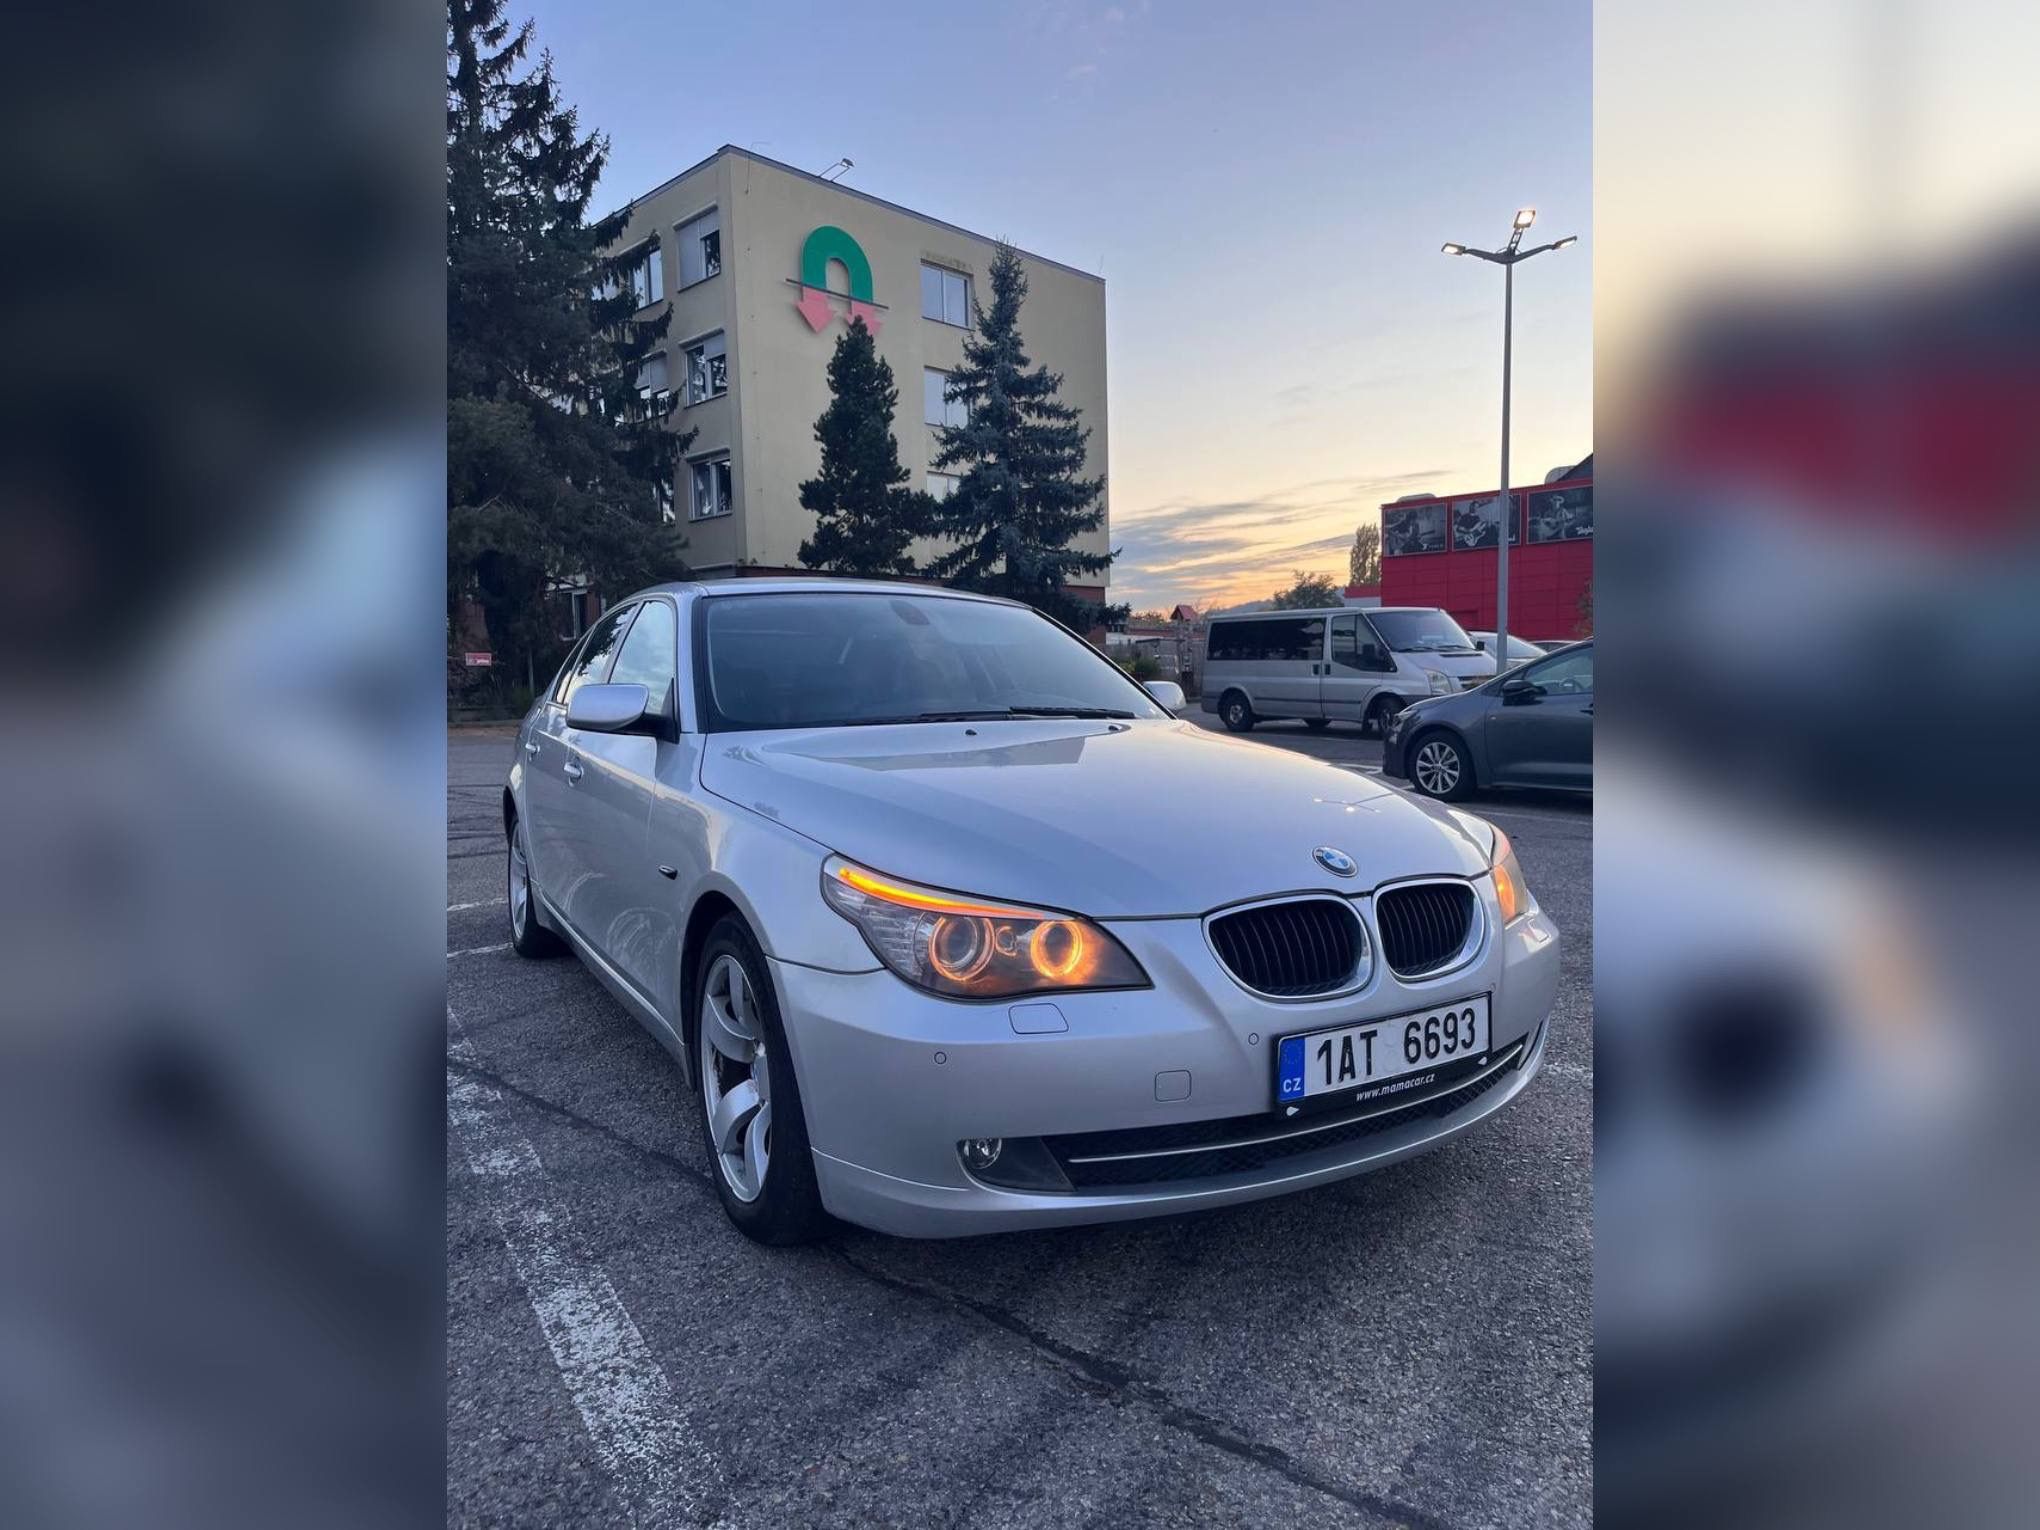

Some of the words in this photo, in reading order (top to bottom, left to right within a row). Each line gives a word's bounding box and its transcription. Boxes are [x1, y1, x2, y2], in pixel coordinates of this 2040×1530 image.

[1317, 1030, 1377, 1085] 1AT
[1403, 1008, 1475, 1064] 6693
[1283, 1077, 1301, 1093] CZ
[1356, 1073, 1435, 1101] www.mamacar.cz
